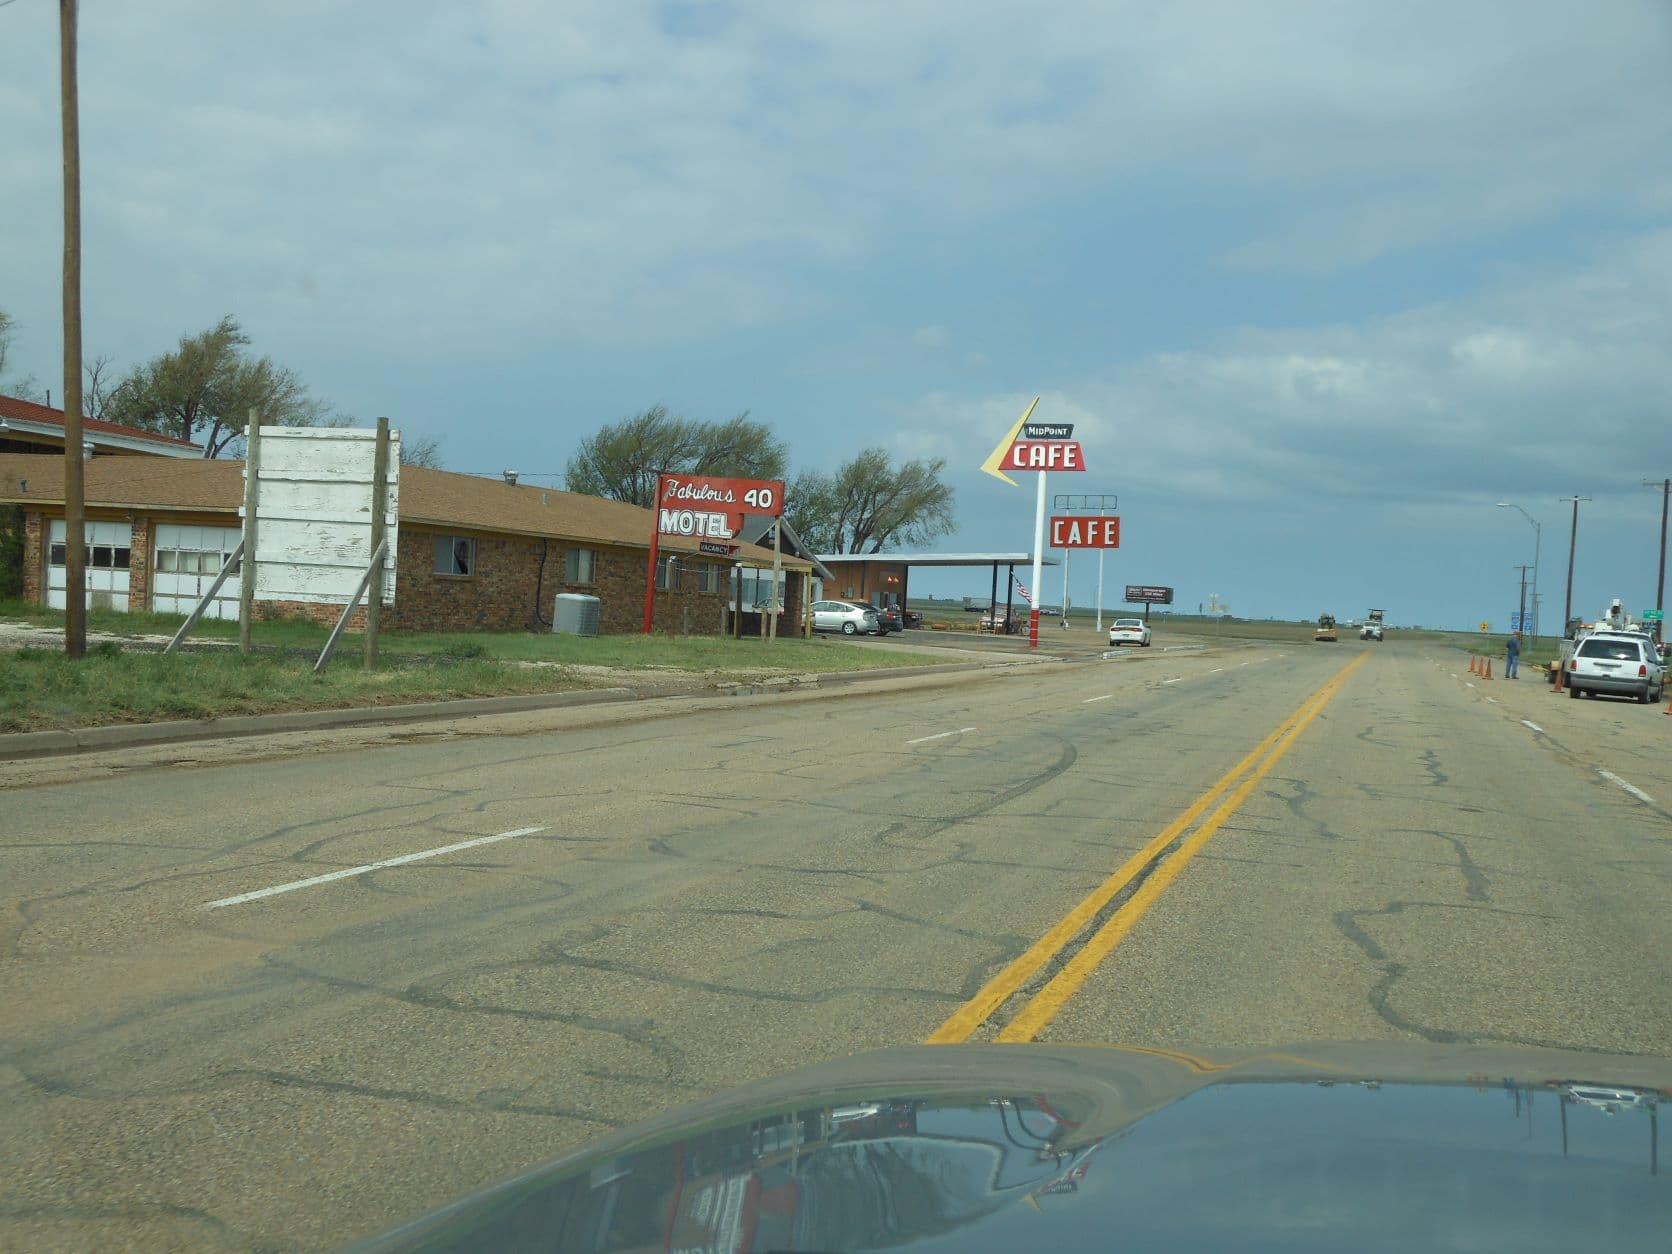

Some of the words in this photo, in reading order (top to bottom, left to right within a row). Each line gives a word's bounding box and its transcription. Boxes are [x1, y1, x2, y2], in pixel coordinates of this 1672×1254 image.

[1013, 444, 1077, 467] CAFE
[663, 479, 737, 503] Fabulous
[744, 488, 773, 508] 40
[659, 508, 733, 540] MOTEL
[1053, 520, 1116, 546] CAFE
[700, 543, 728, 555] VACANCY
